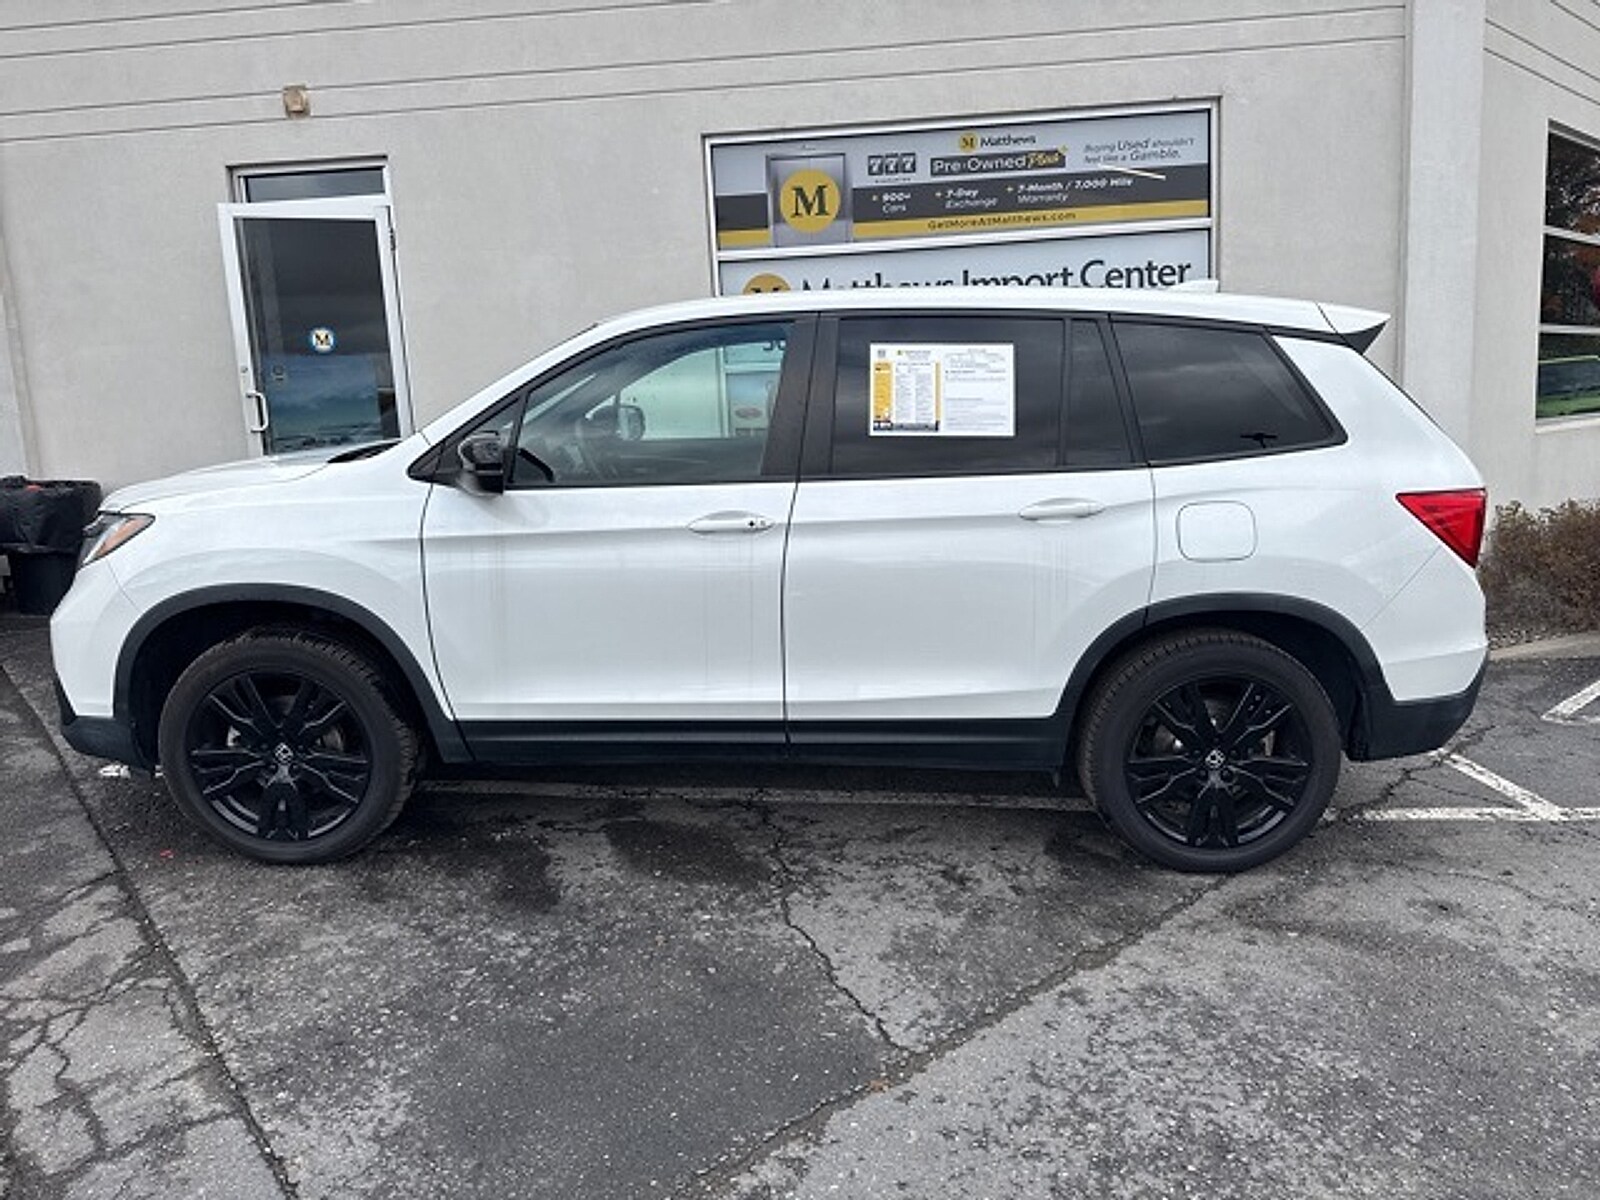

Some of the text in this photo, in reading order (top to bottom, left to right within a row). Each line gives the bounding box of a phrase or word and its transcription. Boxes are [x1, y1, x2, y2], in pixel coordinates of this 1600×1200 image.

[961, 134, 1036, 149] M Matthews
[1117, 138, 1150, 151] Used
[791, 184, 830, 218] M
[945, 197, 998, 209] Exchange
[1017, 193, 1069, 204] Warranty
[882, 204, 907, 214] Cars
[927, 211, 1077, 230] GetMoreAtMatthews.com
[1080, 259, 1192, 289] Center
